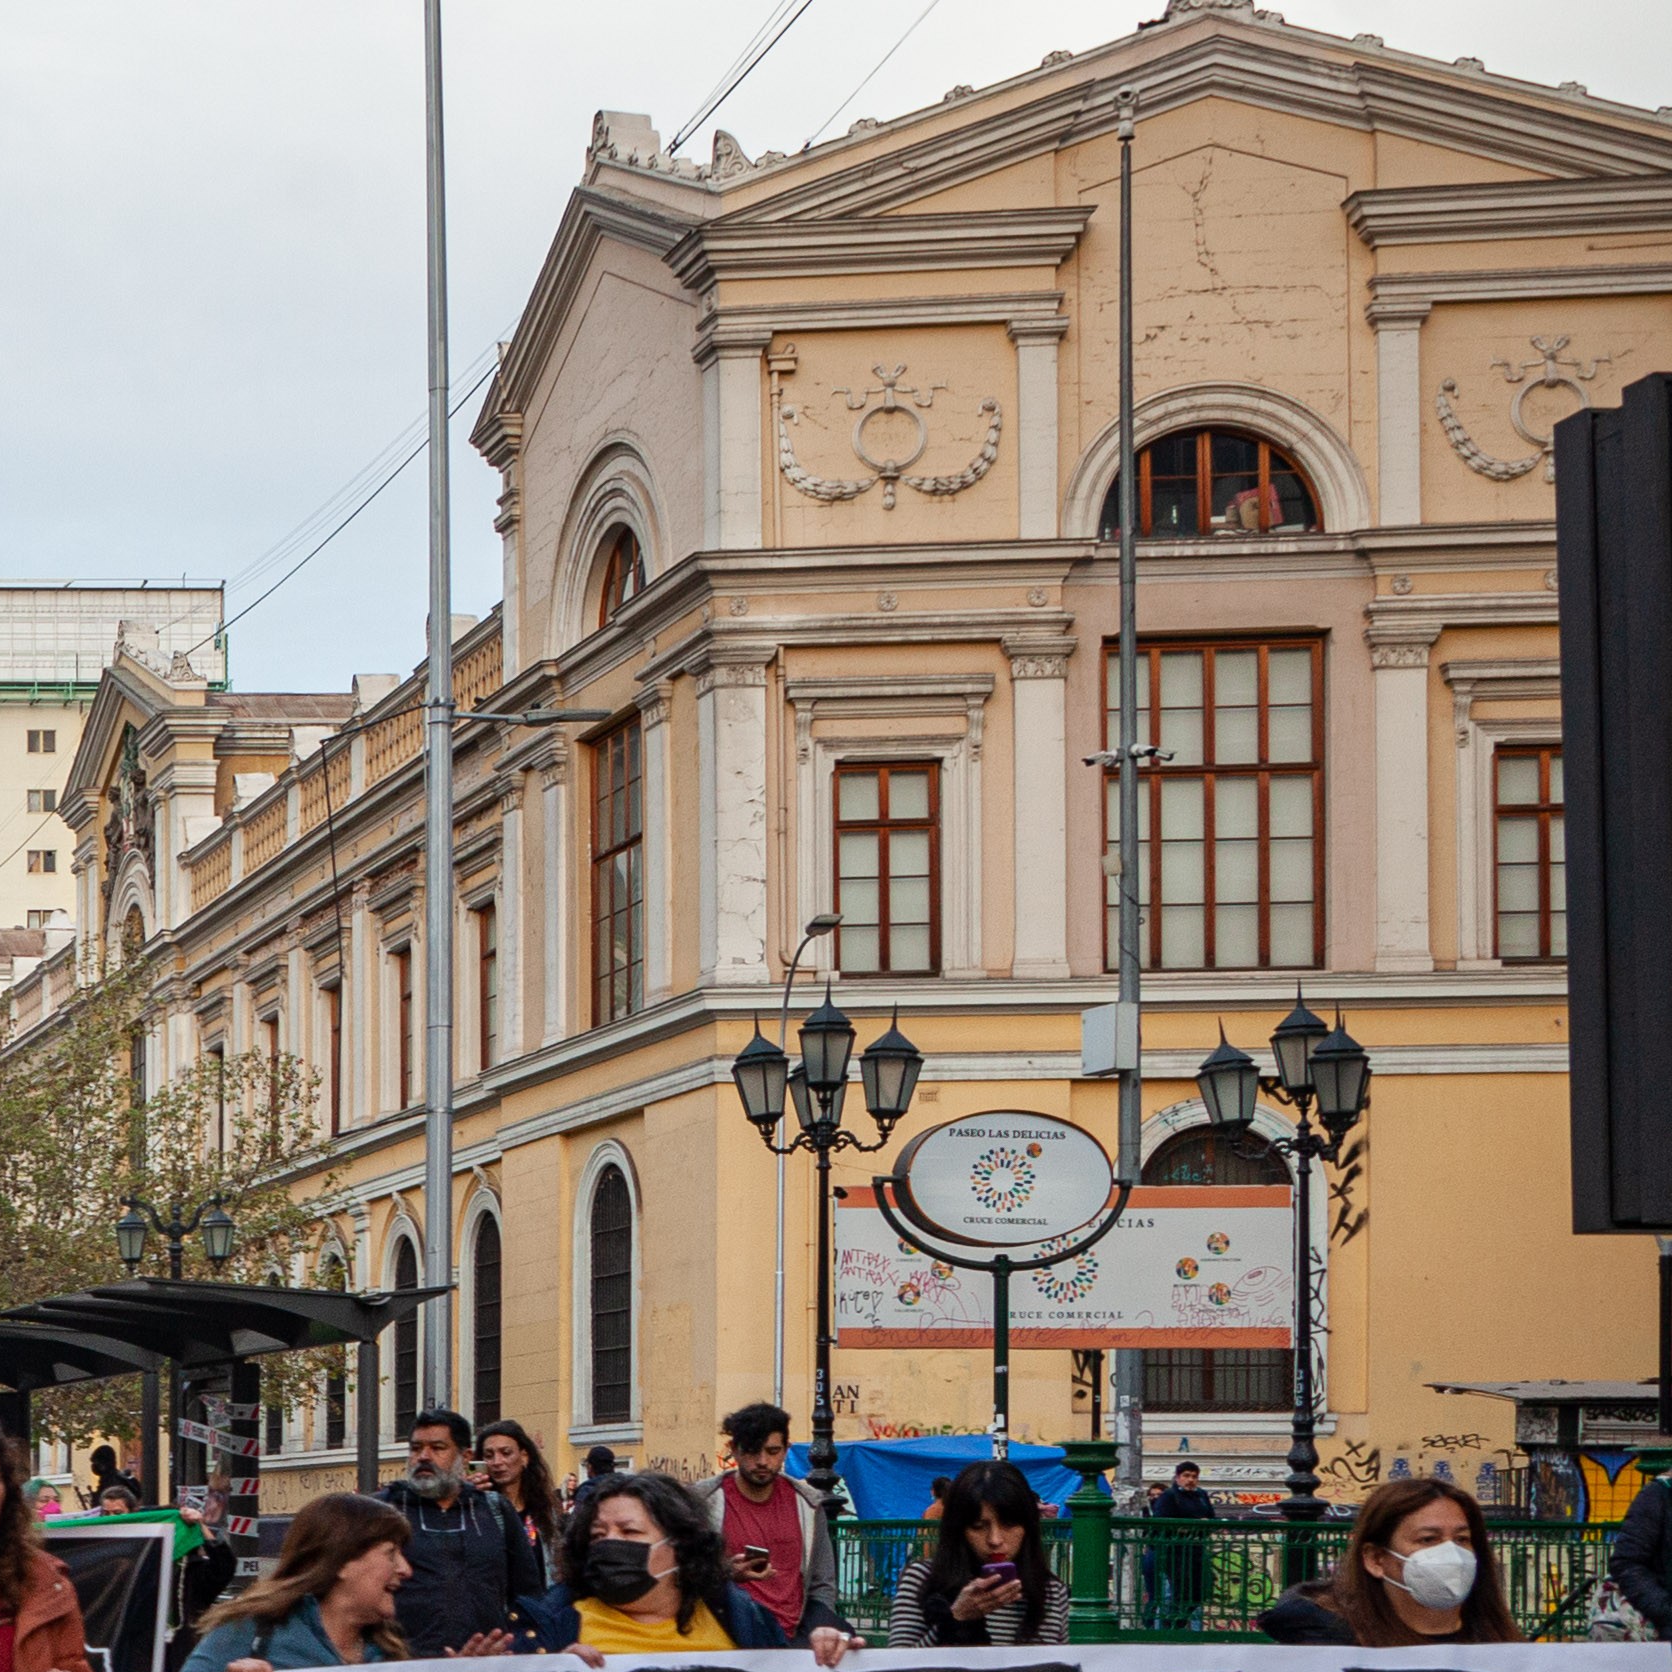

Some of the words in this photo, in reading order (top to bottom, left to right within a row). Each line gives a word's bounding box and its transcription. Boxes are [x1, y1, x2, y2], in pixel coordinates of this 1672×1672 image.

[948, 1128, 986, 1138] PASEO
[988, 1128, 1010, 1139] LAS
[1012, 1129, 1067, 1141] DELICIAS
[963, 1216, 993, 1225] CRUCE
[994, 1216, 1049, 1226] COMERCIAL
[1010, 1311, 1043, 1319] RUCE
[1048, 1311, 1124, 1320] COMERCIAL
